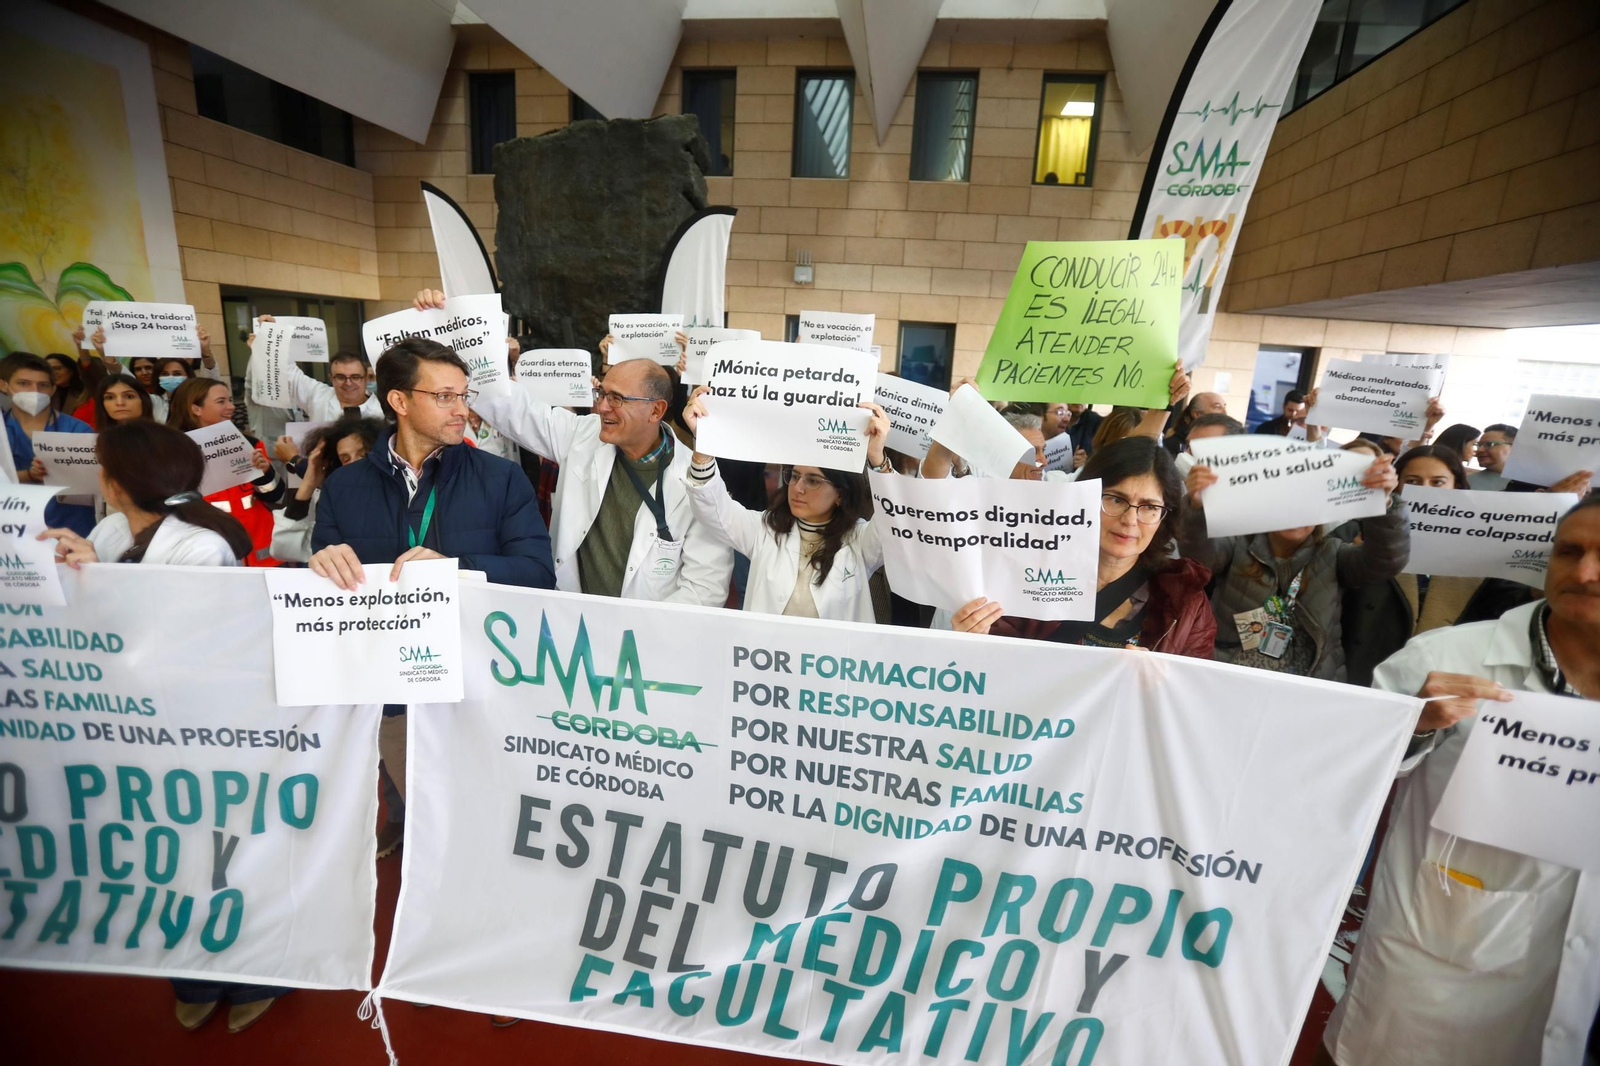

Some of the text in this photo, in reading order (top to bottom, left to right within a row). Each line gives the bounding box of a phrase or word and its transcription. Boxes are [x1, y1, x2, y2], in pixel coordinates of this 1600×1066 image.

[1166, 136, 1250, 181] SMA
[1030, 252, 1141, 289] CONDUCIR
[107, 310, 194, 322] ¡Mónica, traidora!
[1023, 290, 1155, 326] ES ILEGAL,
[111, 321, 187, 331] ¡Stop 24 horas!
[434, 314, 488, 335] médicos,
[620, 330, 668, 340] explotación”
[635, 320, 671, 330] vocación,
[801, 320, 815, 329] “No
[816, 323, 826, 331] es
[827, 322, 863, 333] vocación,
[276, 330, 284, 348] “Sin
[810, 332, 861, 343] explotación”
[1015, 326, 1134, 356] ATENDER
[265, 328, 274, 401] no hay vocación”
[520, 369, 585, 378] vidas enfermas”
[557, 359, 590, 368] eternas,
[712, 359, 860, 387] ¡Mónica petarda,
[992, 358, 1145, 389] PACIENTES NO.
[1326, 370, 1431, 391] “Médicos maltratados,
[1350, 385, 1396, 397] pacientes
[706, 381, 861, 408] haz tú la guardia!
[911, 397, 943, 414] dimite
[1335, 393, 1407, 409] abandonados”
[818, 417, 857, 435] SMA
[914, 415, 927, 424] no
[1527, 409, 1593, 427] “Menos
[34, 442, 97, 454] “No es vocac
[204, 432, 241, 449] médicos,
[1537, 430, 1574, 443] más
[205, 442, 246, 462] políticos”
[1228, 453, 1341, 487] son tu salud”
[873, 493, 1093, 528] “Queremos dignidad,
[891, 525, 1071, 552] no temporalidad”
[1024, 567, 1077, 585] SMA
[273, 587, 450, 610] “Menos explotación,
[1022, 589, 1084, 597] SINDICATO MÉDICO
[296, 612, 431, 636] más protección”
[399, 645, 442, 663] SMA
[483, 608, 703, 716] SMA
[21, 658, 103, 681] SALUD
[427, 668, 449, 676] MÉDICO
[733, 645, 987, 696] POR FORMACIÓN
[43, 690, 157, 717] FAMILIAS
[732, 680, 1076, 741] POR RESPONSABILIDAD
[82, 722, 115, 742] DE
[118, 724, 177, 746] UNA
[180, 724, 321, 752] PROFESIÓN
[1481, 714, 1591, 752] “Menos
[731, 715, 1033, 775] POR NUESTRA SALUD
[503, 735, 694, 780] SINDICATO MÉDICO
[1497, 754, 1561, 777] más
[536, 764, 665, 802] DE CÓRDOBA
[730, 750, 1085, 814] POR NUESTRAS FAMILIAS
[63, 763, 319, 835] PROPIO
[729, 783, 1263, 885] POR LA DIGNIDAD DE UNA PROFESIÓN
[211, 830, 241, 891] Y
[512, 794, 1233, 969] ESTATUTO PROPIO
[578, 878, 1130, 1014] DEL MÉDICO Y
[569, 953, 1105, 1066] FACULTATIVO
